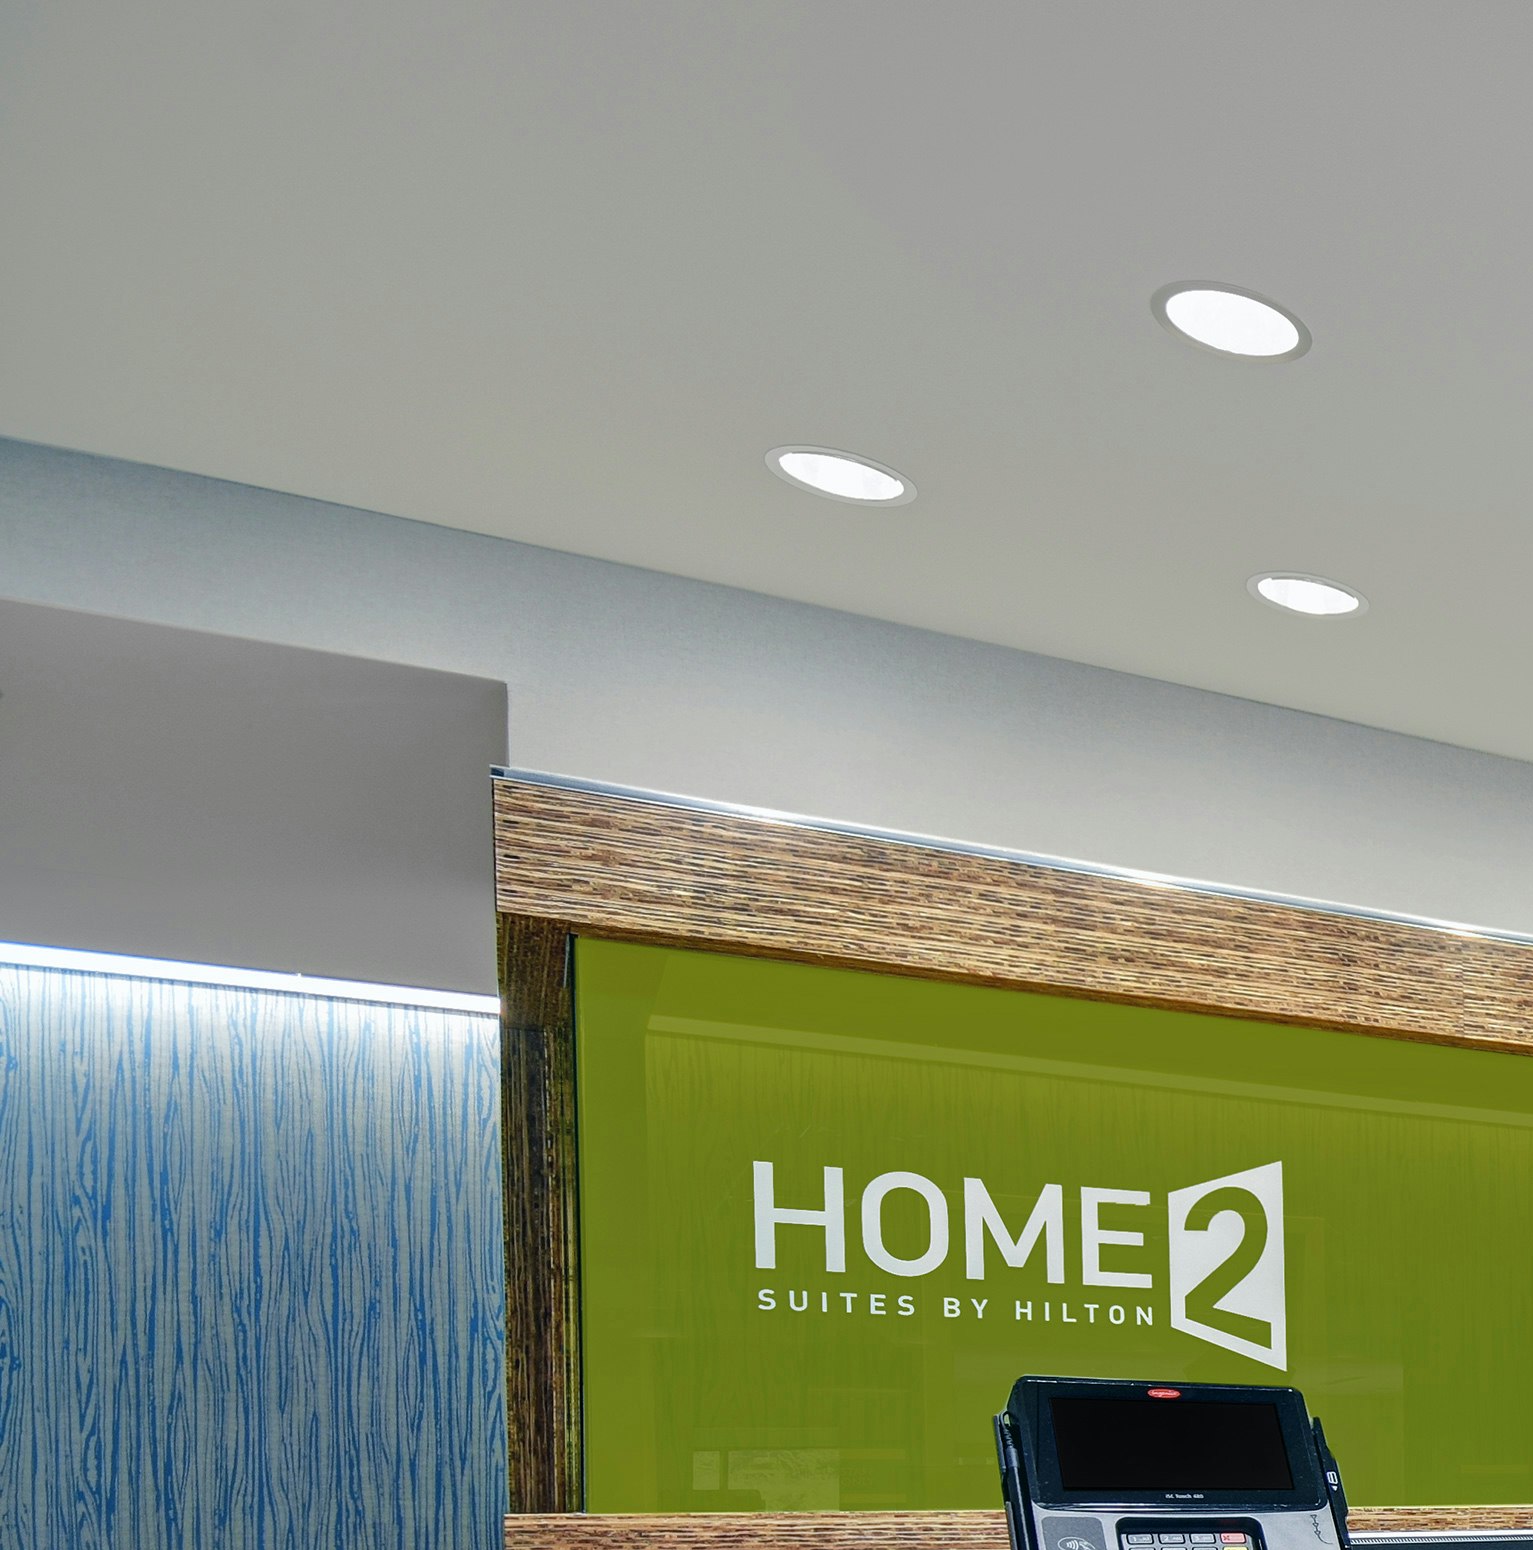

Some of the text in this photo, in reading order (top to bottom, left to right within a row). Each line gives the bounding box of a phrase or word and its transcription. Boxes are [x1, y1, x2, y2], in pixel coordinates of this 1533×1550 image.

[758, 1288, 1154, 1326] SUITES BY HILTON
